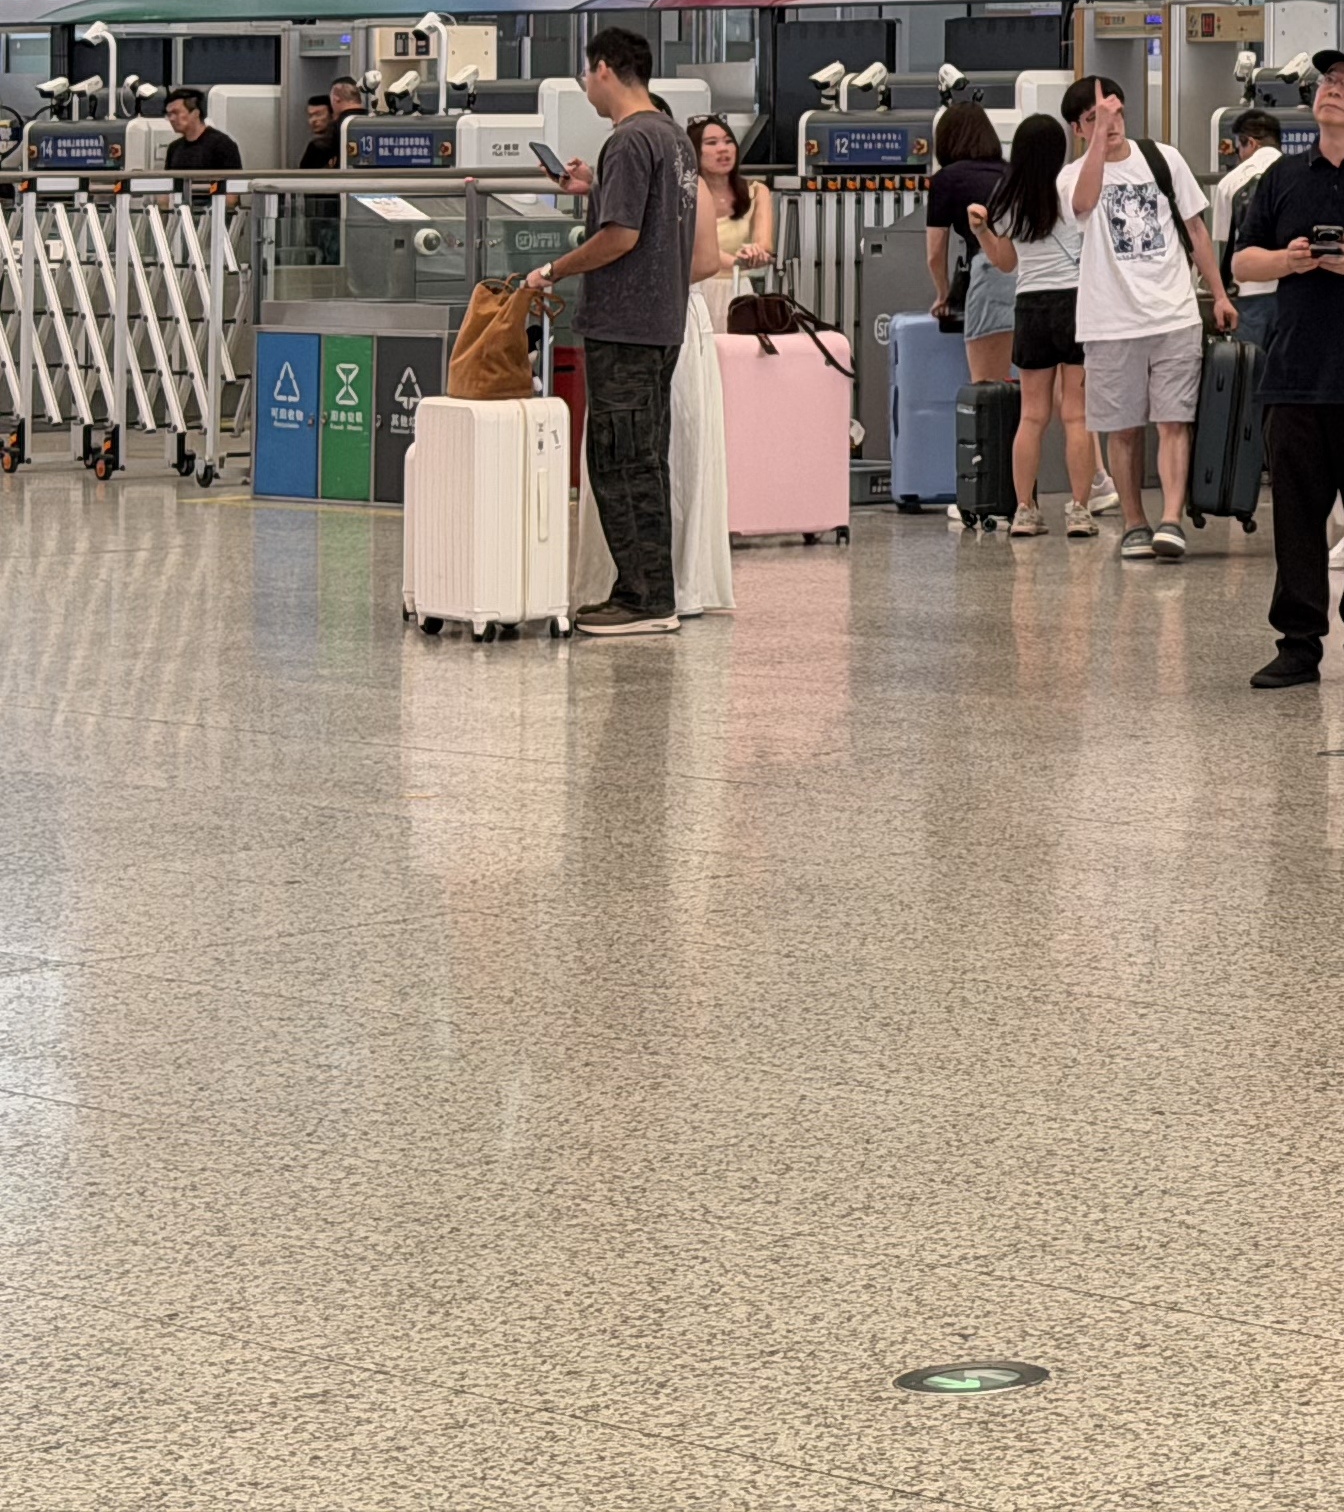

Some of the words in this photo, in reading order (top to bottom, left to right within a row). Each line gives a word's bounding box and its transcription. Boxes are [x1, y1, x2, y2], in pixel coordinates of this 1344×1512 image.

[41, 139, 53, 158] 14
[360, 135, 373, 153] 13
[835, 137, 848, 154] 12
